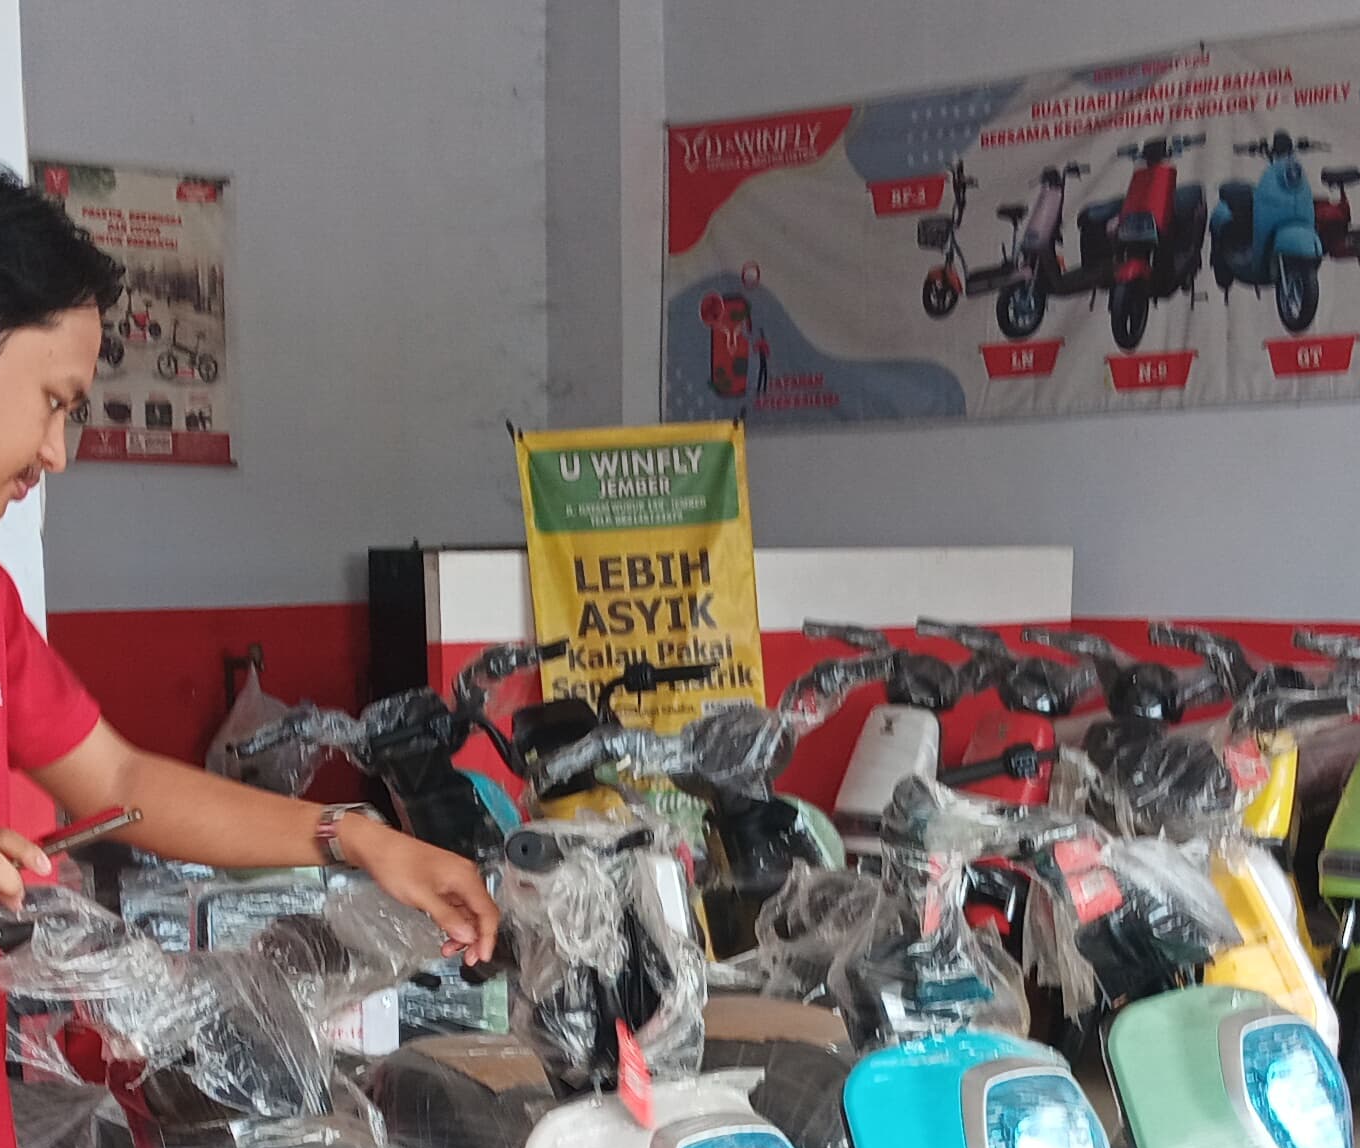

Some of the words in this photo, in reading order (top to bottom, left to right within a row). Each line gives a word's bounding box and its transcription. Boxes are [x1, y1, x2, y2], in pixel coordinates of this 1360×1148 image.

[980, 122, 1051, 149] BERSAMA
[1293, 81, 1351, 108] WINFLY
[559, 452, 581, 482] U
[589, 445, 704, 480] WINFLY
[599, 476, 672, 500] JEMBER
[573, 547, 712, 595] LEBIH
[578, 593, 718, 639] ASYIK
